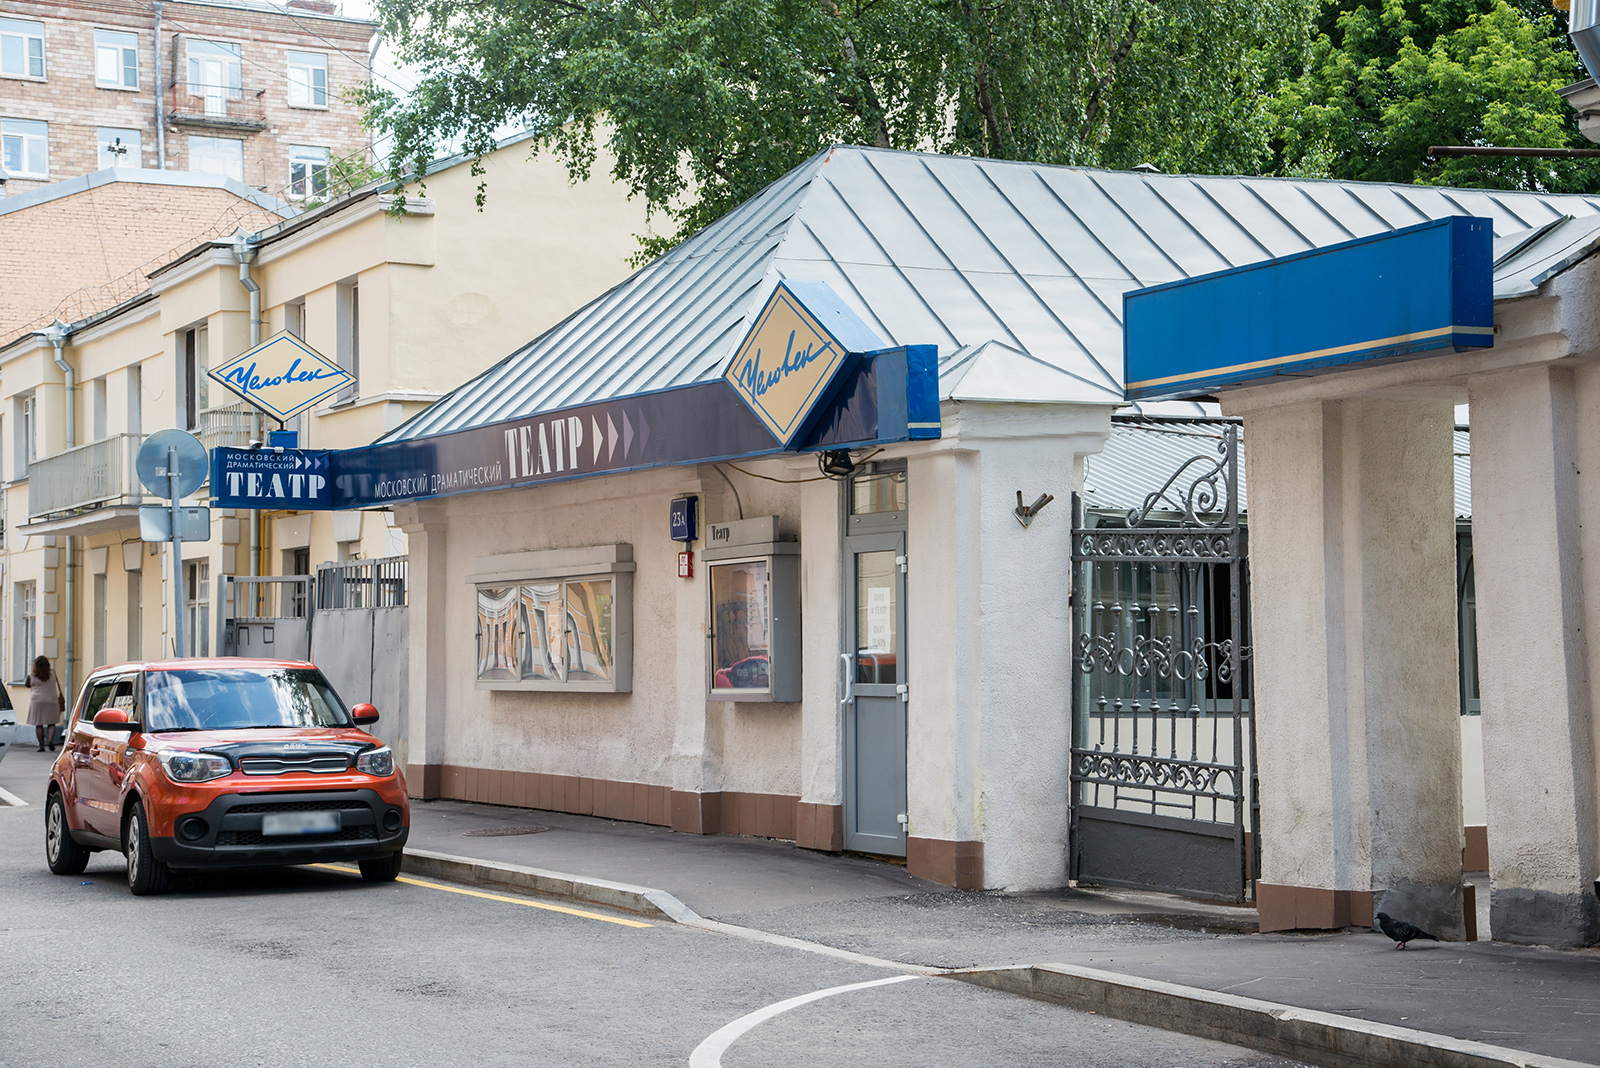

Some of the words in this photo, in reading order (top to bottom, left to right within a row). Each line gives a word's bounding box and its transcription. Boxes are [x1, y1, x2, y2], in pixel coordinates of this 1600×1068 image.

[225, 358, 346, 394] Человек
[739, 329, 833, 405] Человек
[226, 453, 295, 462] МОСКОВСКИЙ
[226, 461, 295, 470] ДРАМАТИЧЕСКИЙ
[374, 473, 428, 498] МОСКОВСКИЙ
[431, 461, 502, 494] ДРАМАТИЧЕСКИЙ
[504, 415, 584, 480] ТЕАТР
[226, 472, 326, 499] ТЕАТР
[711, 525, 730, 542] Театр
